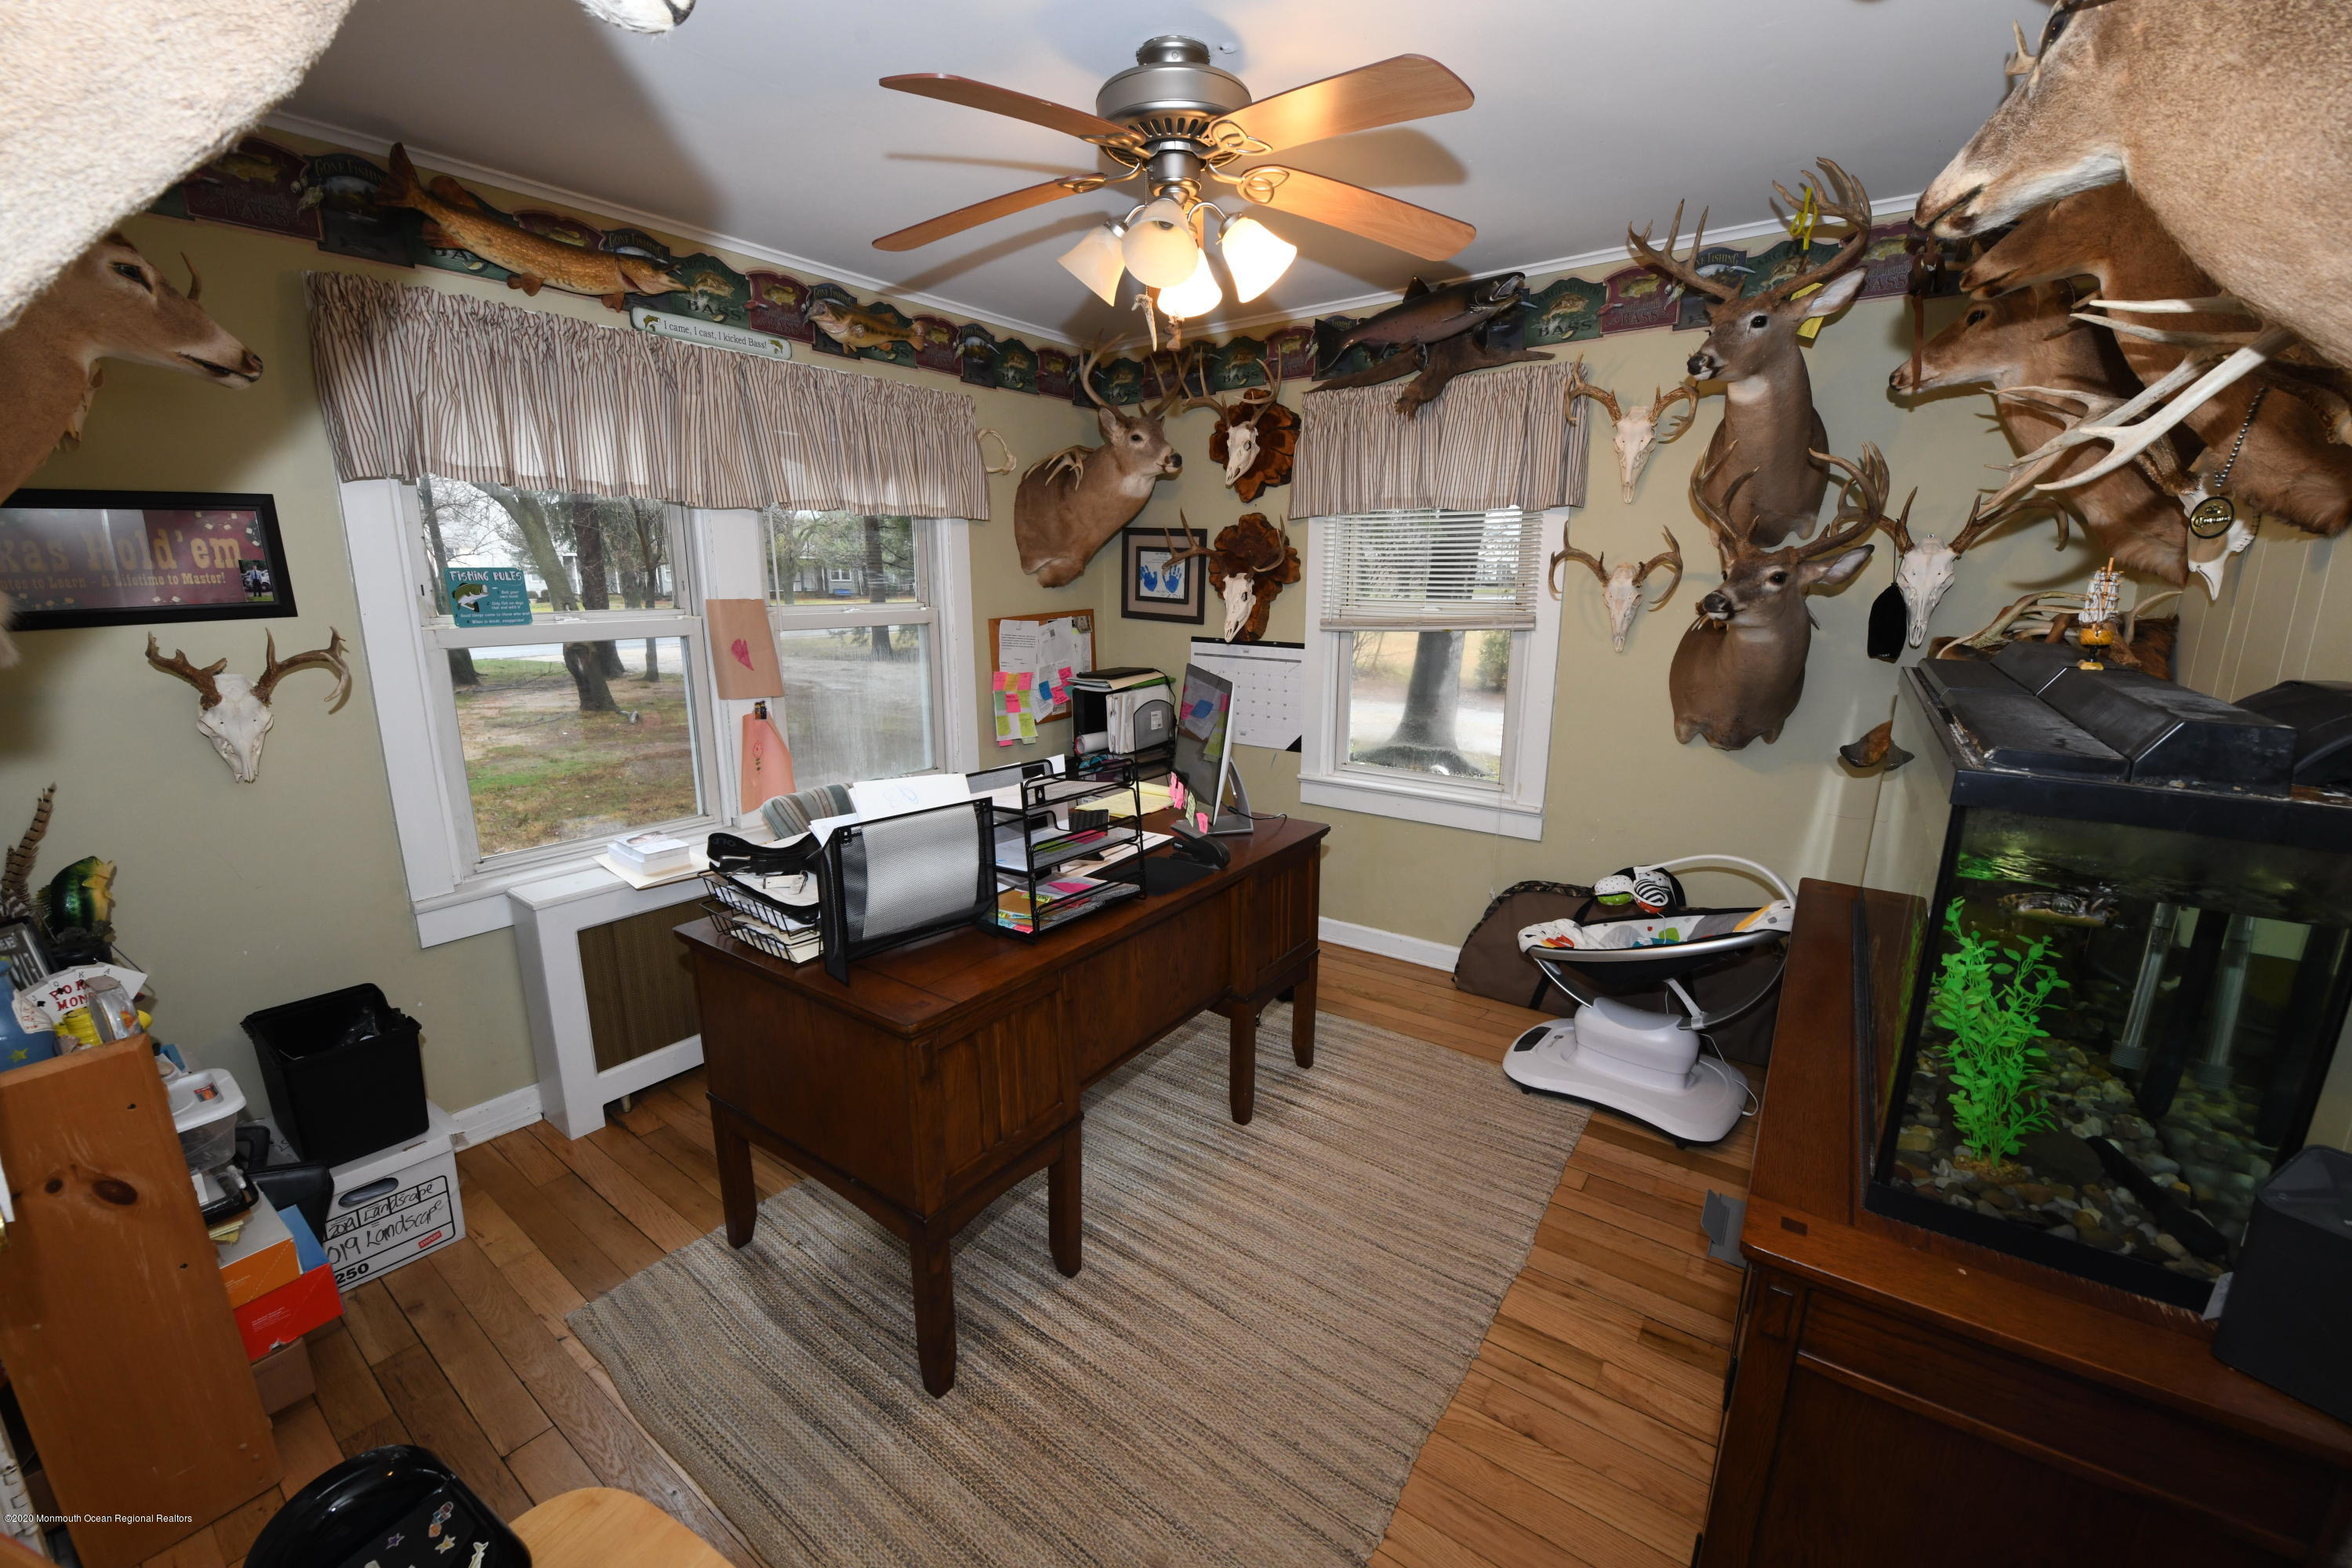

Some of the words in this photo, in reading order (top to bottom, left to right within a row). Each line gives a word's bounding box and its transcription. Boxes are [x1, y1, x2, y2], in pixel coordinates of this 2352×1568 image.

[669, 322, 692, 336] came,
[699, 328, 717, 341] cast,
[723, 332, 746, 345] kicked
[748, 337, 768, 350] Bass!
[113, 572, 165, 587] Lifetime
[167, 573, 180, 586] to
[181, 572, 227, 586] Master!
[492, 571, 523, 581] RULES
[56, 994, 89, 1011] MON
[327, 1236, 361, 1265] 019
